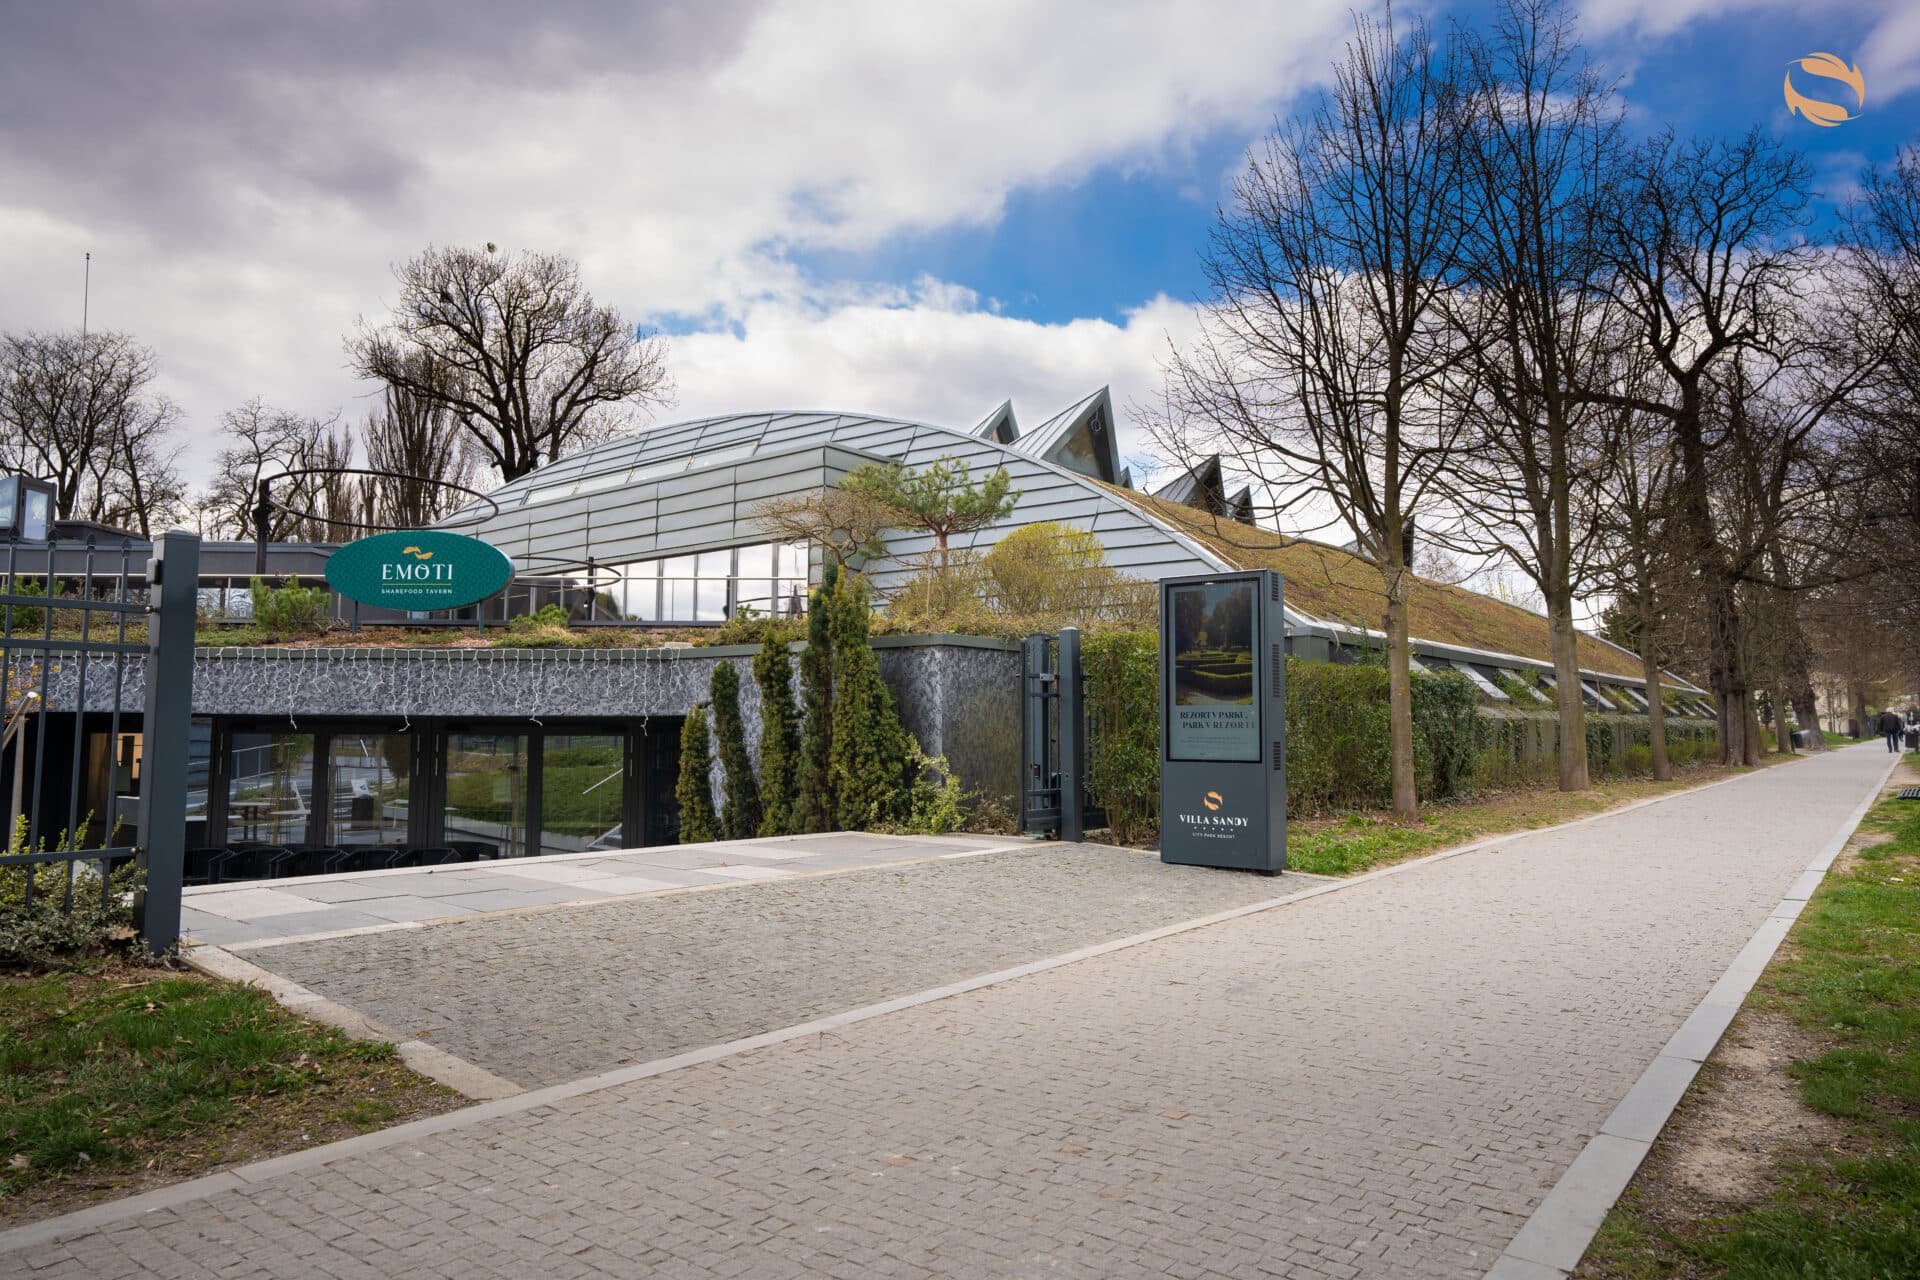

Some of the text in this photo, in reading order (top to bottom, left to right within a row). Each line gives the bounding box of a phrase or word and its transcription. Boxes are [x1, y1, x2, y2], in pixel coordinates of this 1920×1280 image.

[382, 563, 453, 580] EMOTI
[1180, 711, 1210, 719] REZORT
[1182, 721, 1204, 729] PARK
[1179, 814, 1248, 827] VILLA SANDY
